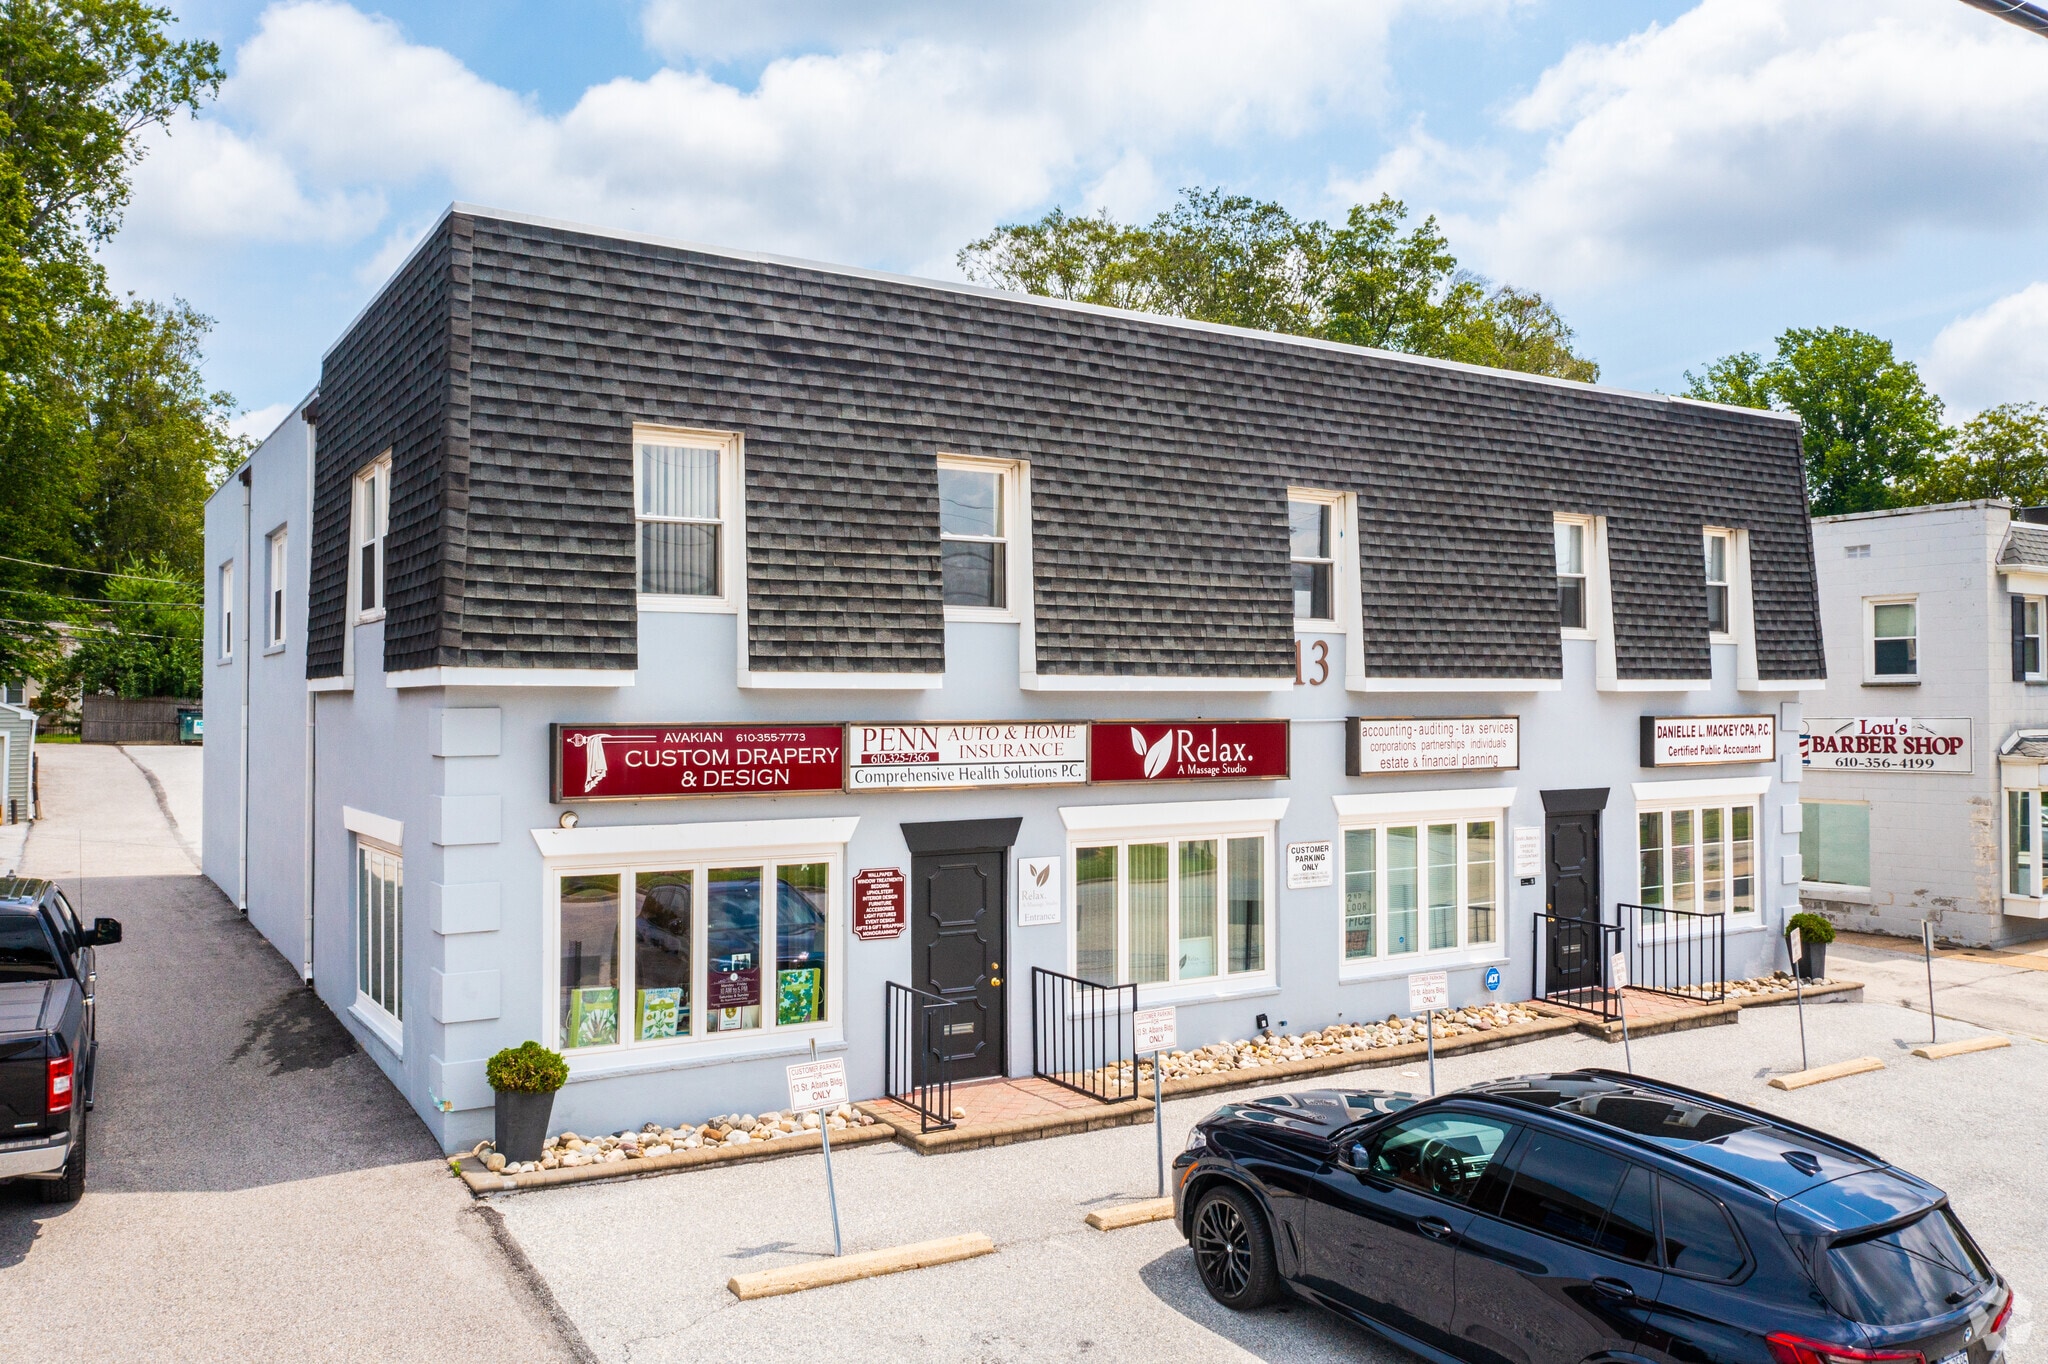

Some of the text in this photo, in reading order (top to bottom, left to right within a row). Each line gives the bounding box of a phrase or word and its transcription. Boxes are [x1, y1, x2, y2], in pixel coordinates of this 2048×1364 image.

[1294, 640, 1328, 685] 13
[1462, 723, 1475, 734] tax
[1479, 722, 1514, 734] services
[1657, 723, 1771, 739] DANIELLE L. MACKEY CPA, P.C.
[1859, 718, 1908, 735] Lou's
[663, 732, 806, 743] AVAKIAN 610-355-7773
[862, 725, 1076, 752] PENN AUTO & HOME
[959, 742, 1064, 759] INSURANCE
[1177, 728, 1253, 762] Relax.
[1370, 738, 1506, 753] corporations partnerships individuals
[1668, 744, 1761, 757] Certified Public Accountant
[1812, 736, 1964, 755] BARBER SHOP
[625, 747, 839, 768] CUSTOM DRAPERY
[871, 752, 930, 763] 610-325-7366
[1380, 754, 1498, 769] estate & financial planning
[1835, 757, 1934, 769] 610-356-4199
[855, 764, 1082, 786] Comprehensive Health Solutions P.C.
[1178, 763, 1247, 776] A Massage Studio
[681, 769, 790, 788] & DESIGN
[1291, 845, 1329, 854] CUSTOMER
[1295, 854, 1326, 862] PARKING
[1024, 913, 1056, 922] Entrance
[1488, 974, 1498, 984] ADT
[1149, 1034, 1164, 1043] ONLY
[812, 1089, 831, 1100] ONLY
